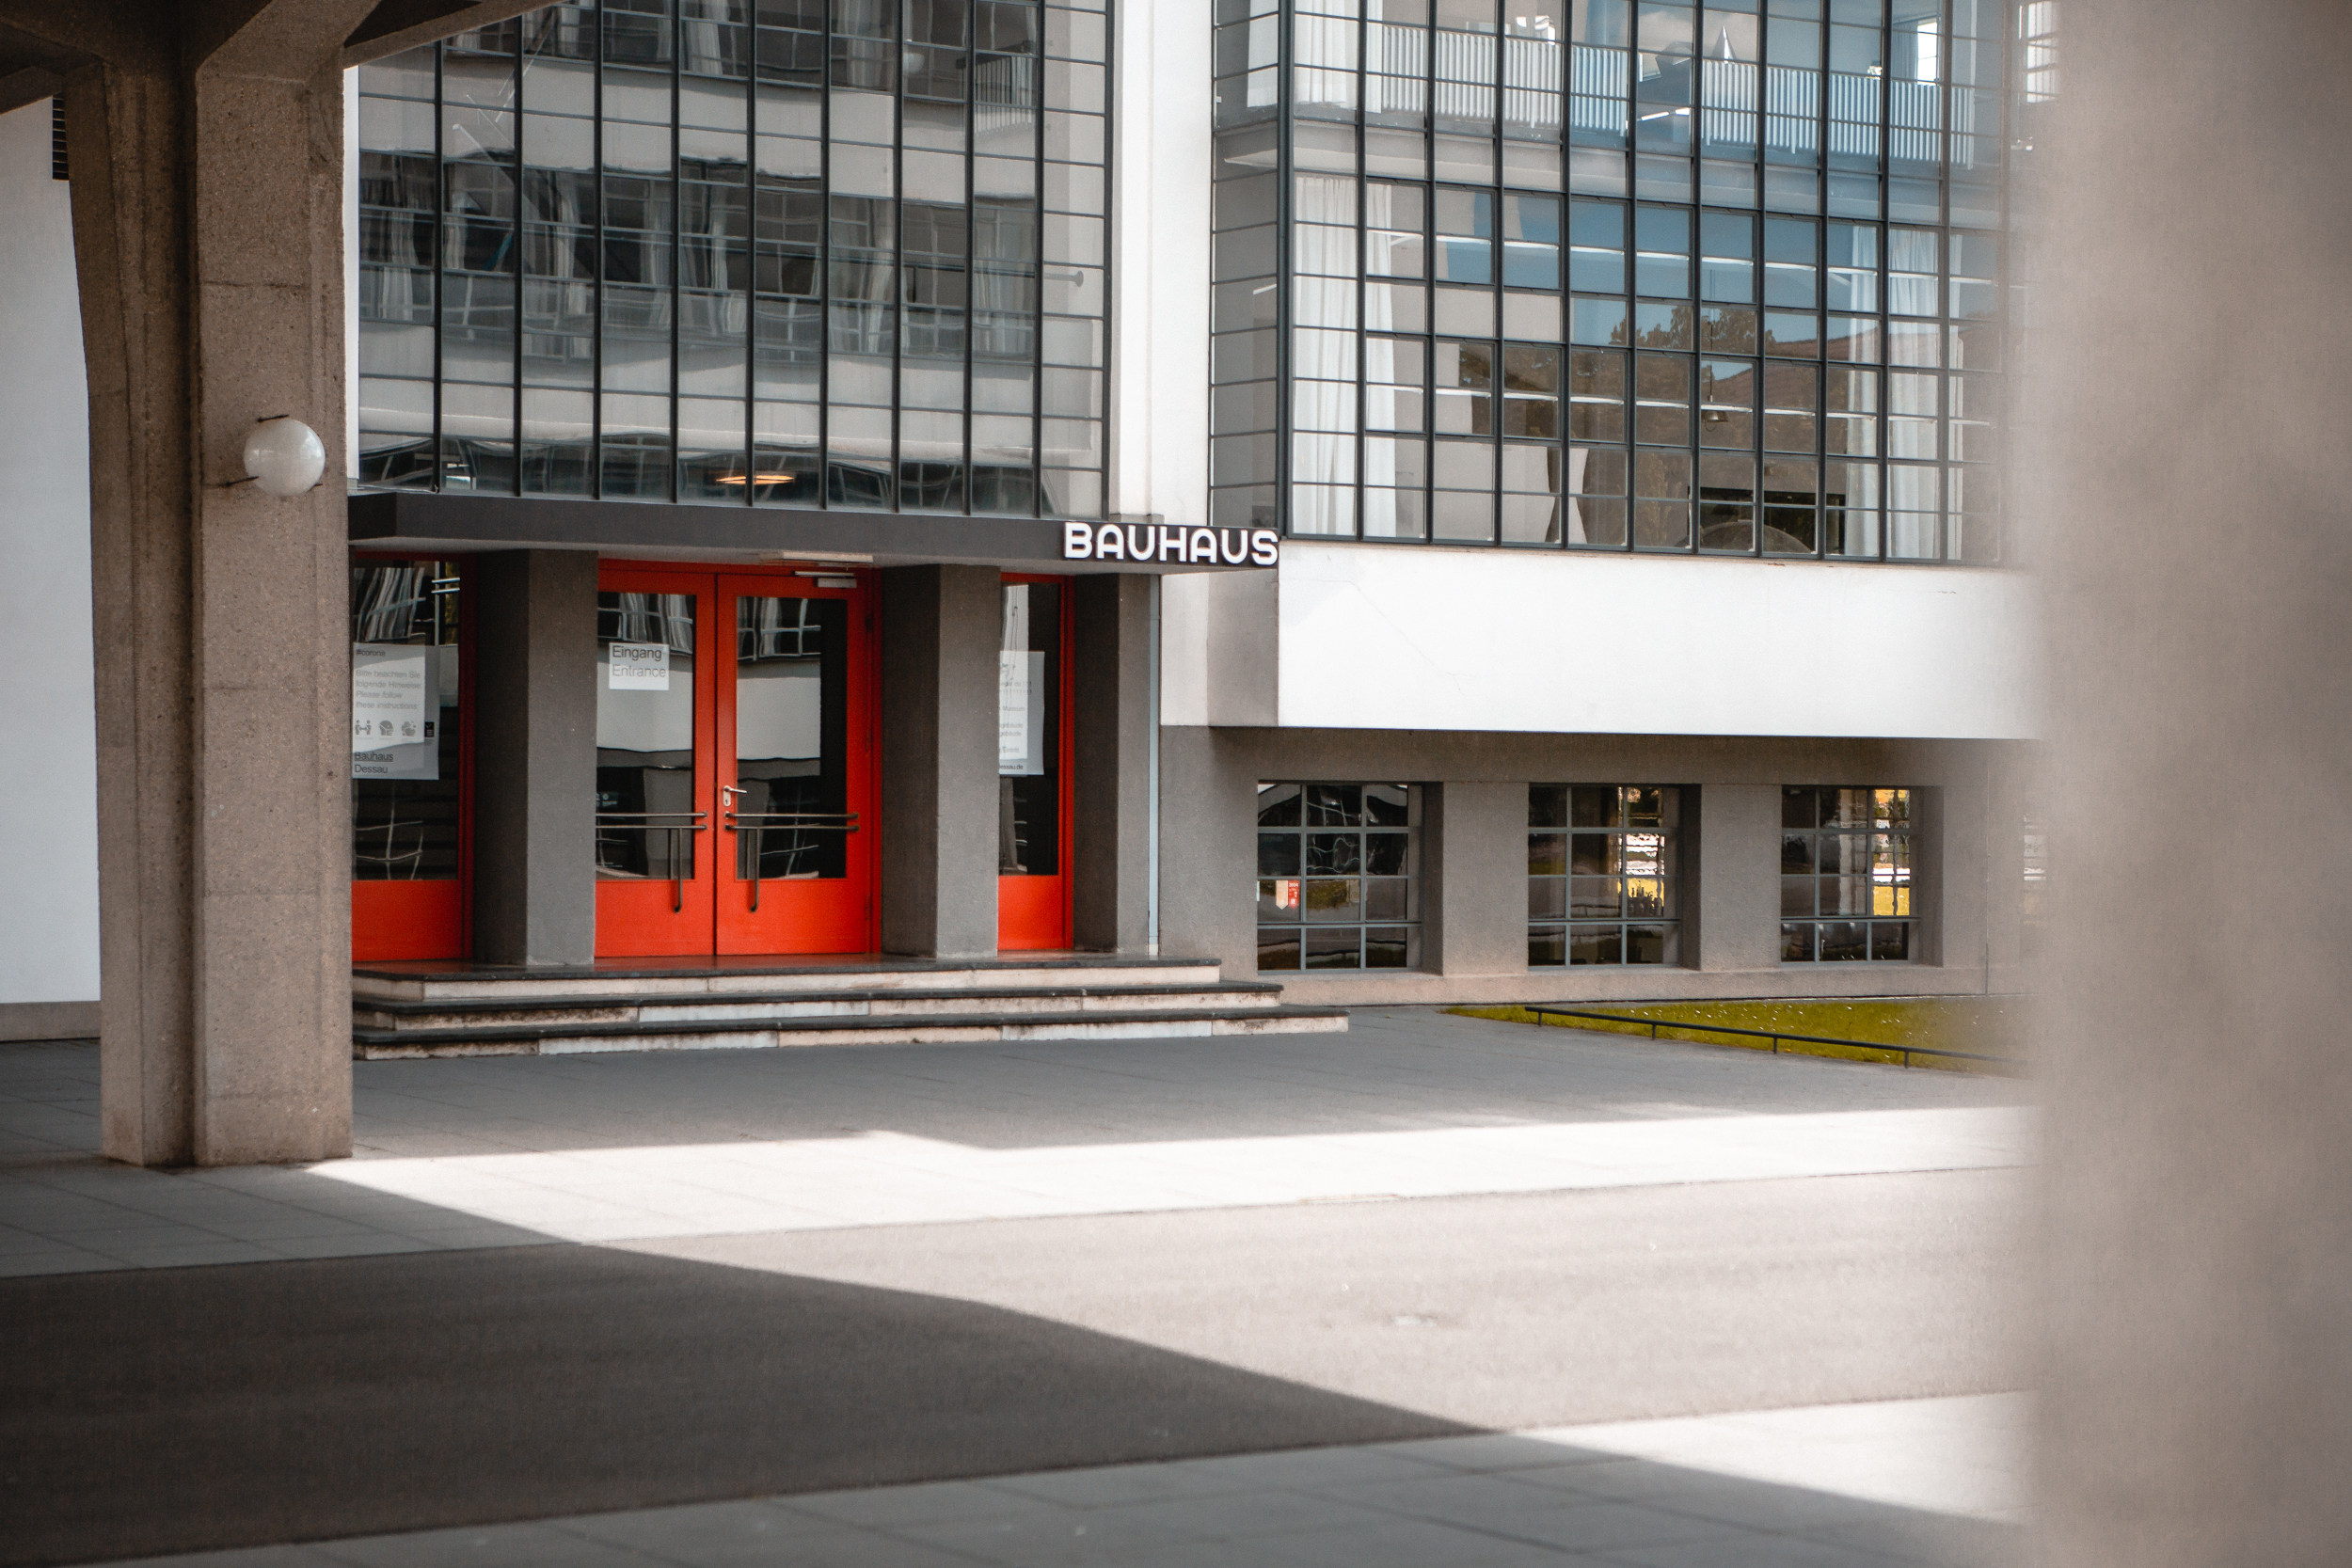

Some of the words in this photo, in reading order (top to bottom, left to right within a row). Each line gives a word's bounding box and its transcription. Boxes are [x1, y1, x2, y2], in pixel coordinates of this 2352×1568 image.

[1065, 522, 1279, 565] BAUHAUS
[612, 645, 662, 661] Eingang
[612, 664, 666, 677] Entrance
[355, 752, 394, 762] Bauhaus
[355, 765, 389, 774] Dessau
